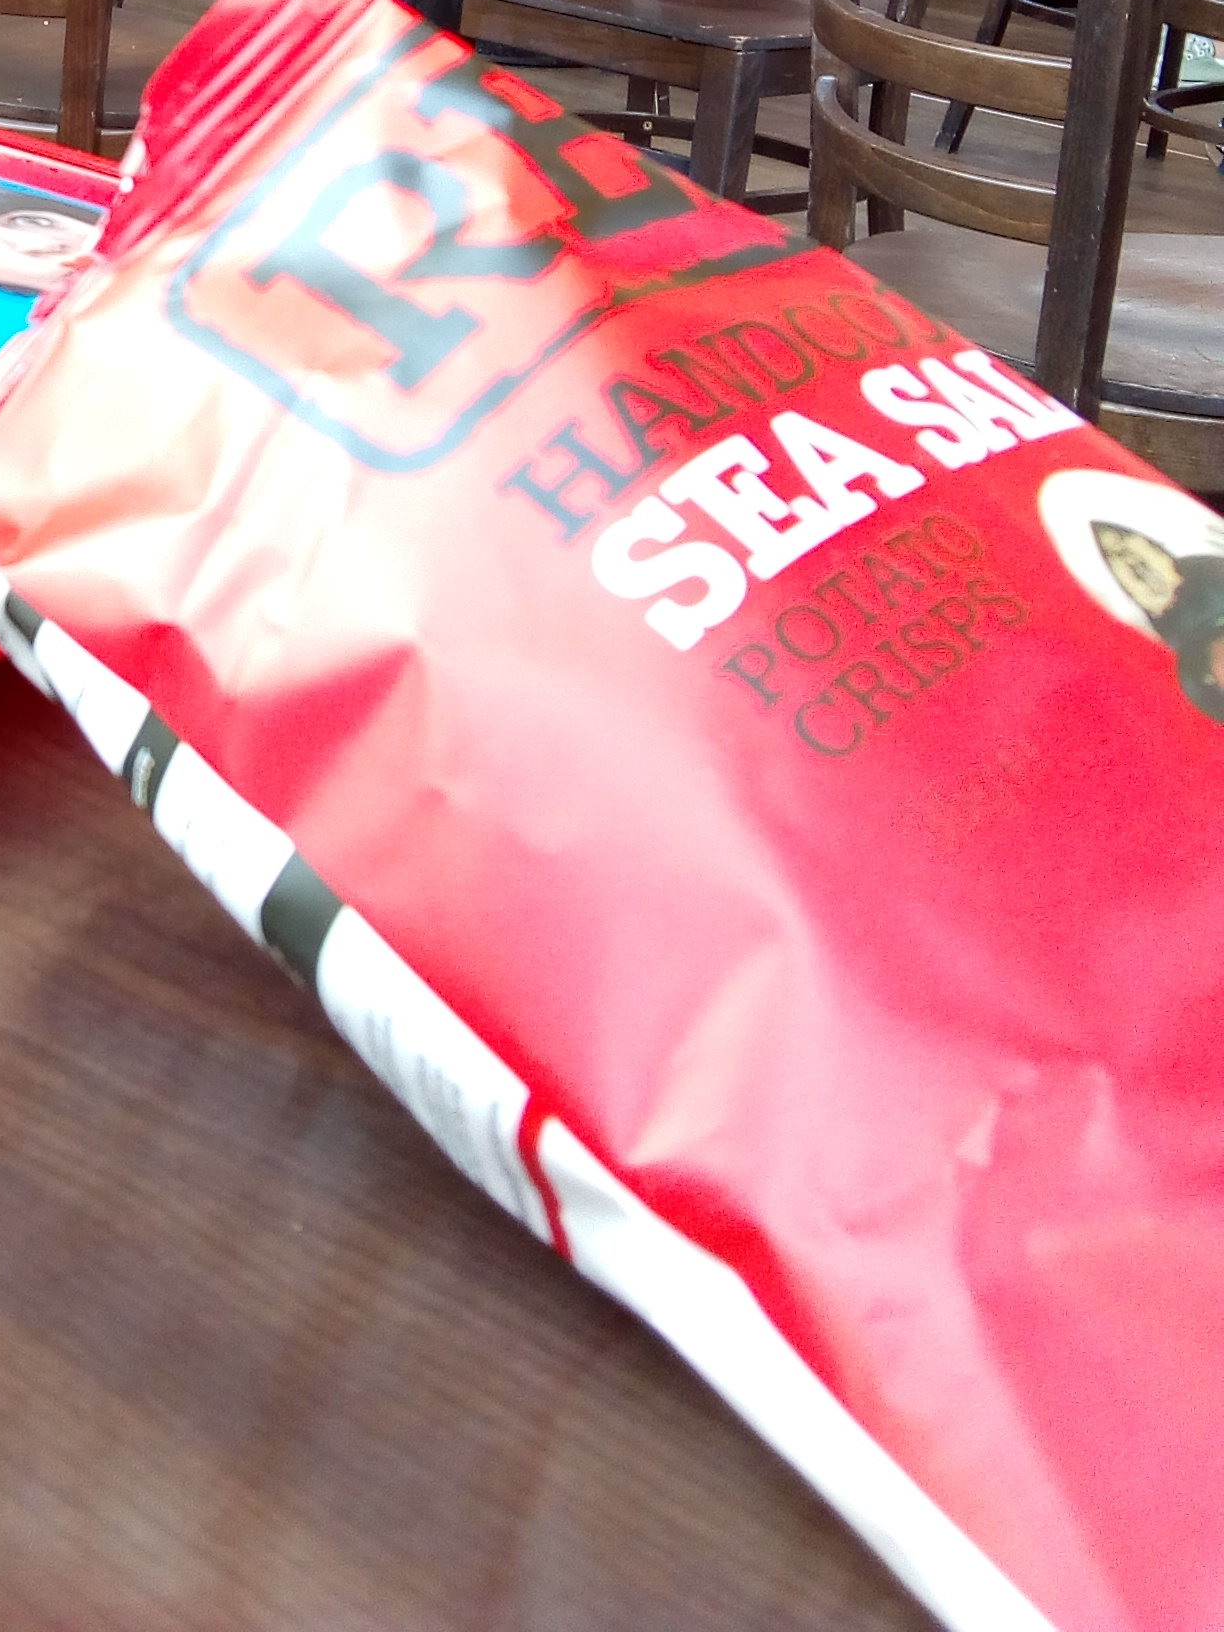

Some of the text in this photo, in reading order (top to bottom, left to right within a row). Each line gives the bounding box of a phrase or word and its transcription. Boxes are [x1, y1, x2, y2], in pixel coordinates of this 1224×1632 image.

[590, 410, 927, 652] SEA
[722, 512, 983, 709] POTATO
[790, 574, 1029, 760] CRISPS
